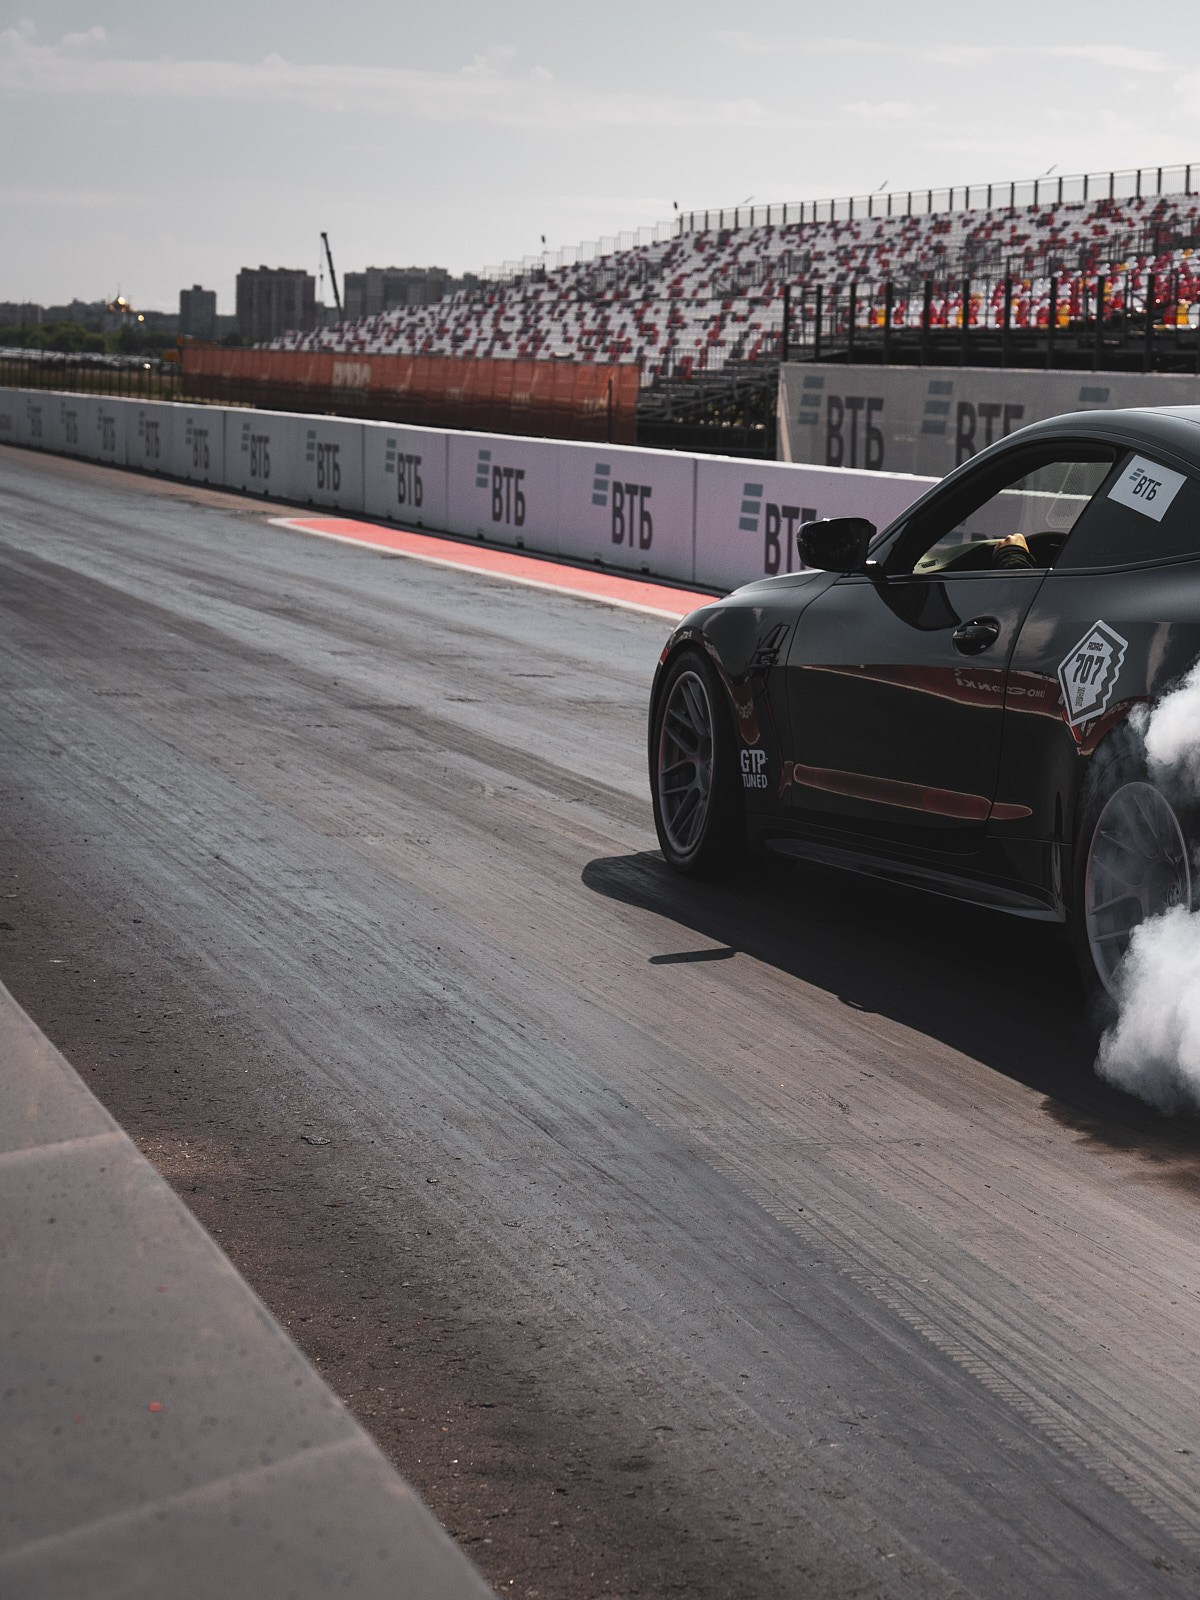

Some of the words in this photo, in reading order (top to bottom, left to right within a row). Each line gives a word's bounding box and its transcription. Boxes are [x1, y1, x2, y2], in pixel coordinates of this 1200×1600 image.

[250, 433, 270, 479] ВТБ
[826, 395, 885, 470] ВТБ
[317, 442, 341, 491] ВТБ
[397, 453, 424, 508] ВТБ
[1132, 475, 1162, 501] ВТБ
[491, 464, 526, 526] ВТБ
[611, 480, 653, 550] ВТБ
[764, 503, 818, 574] ВТ
[1073, 653, 1105, 685] 707
[741, 750, 767, 773] GTP
[742, 774, 767, 788] TUNED
